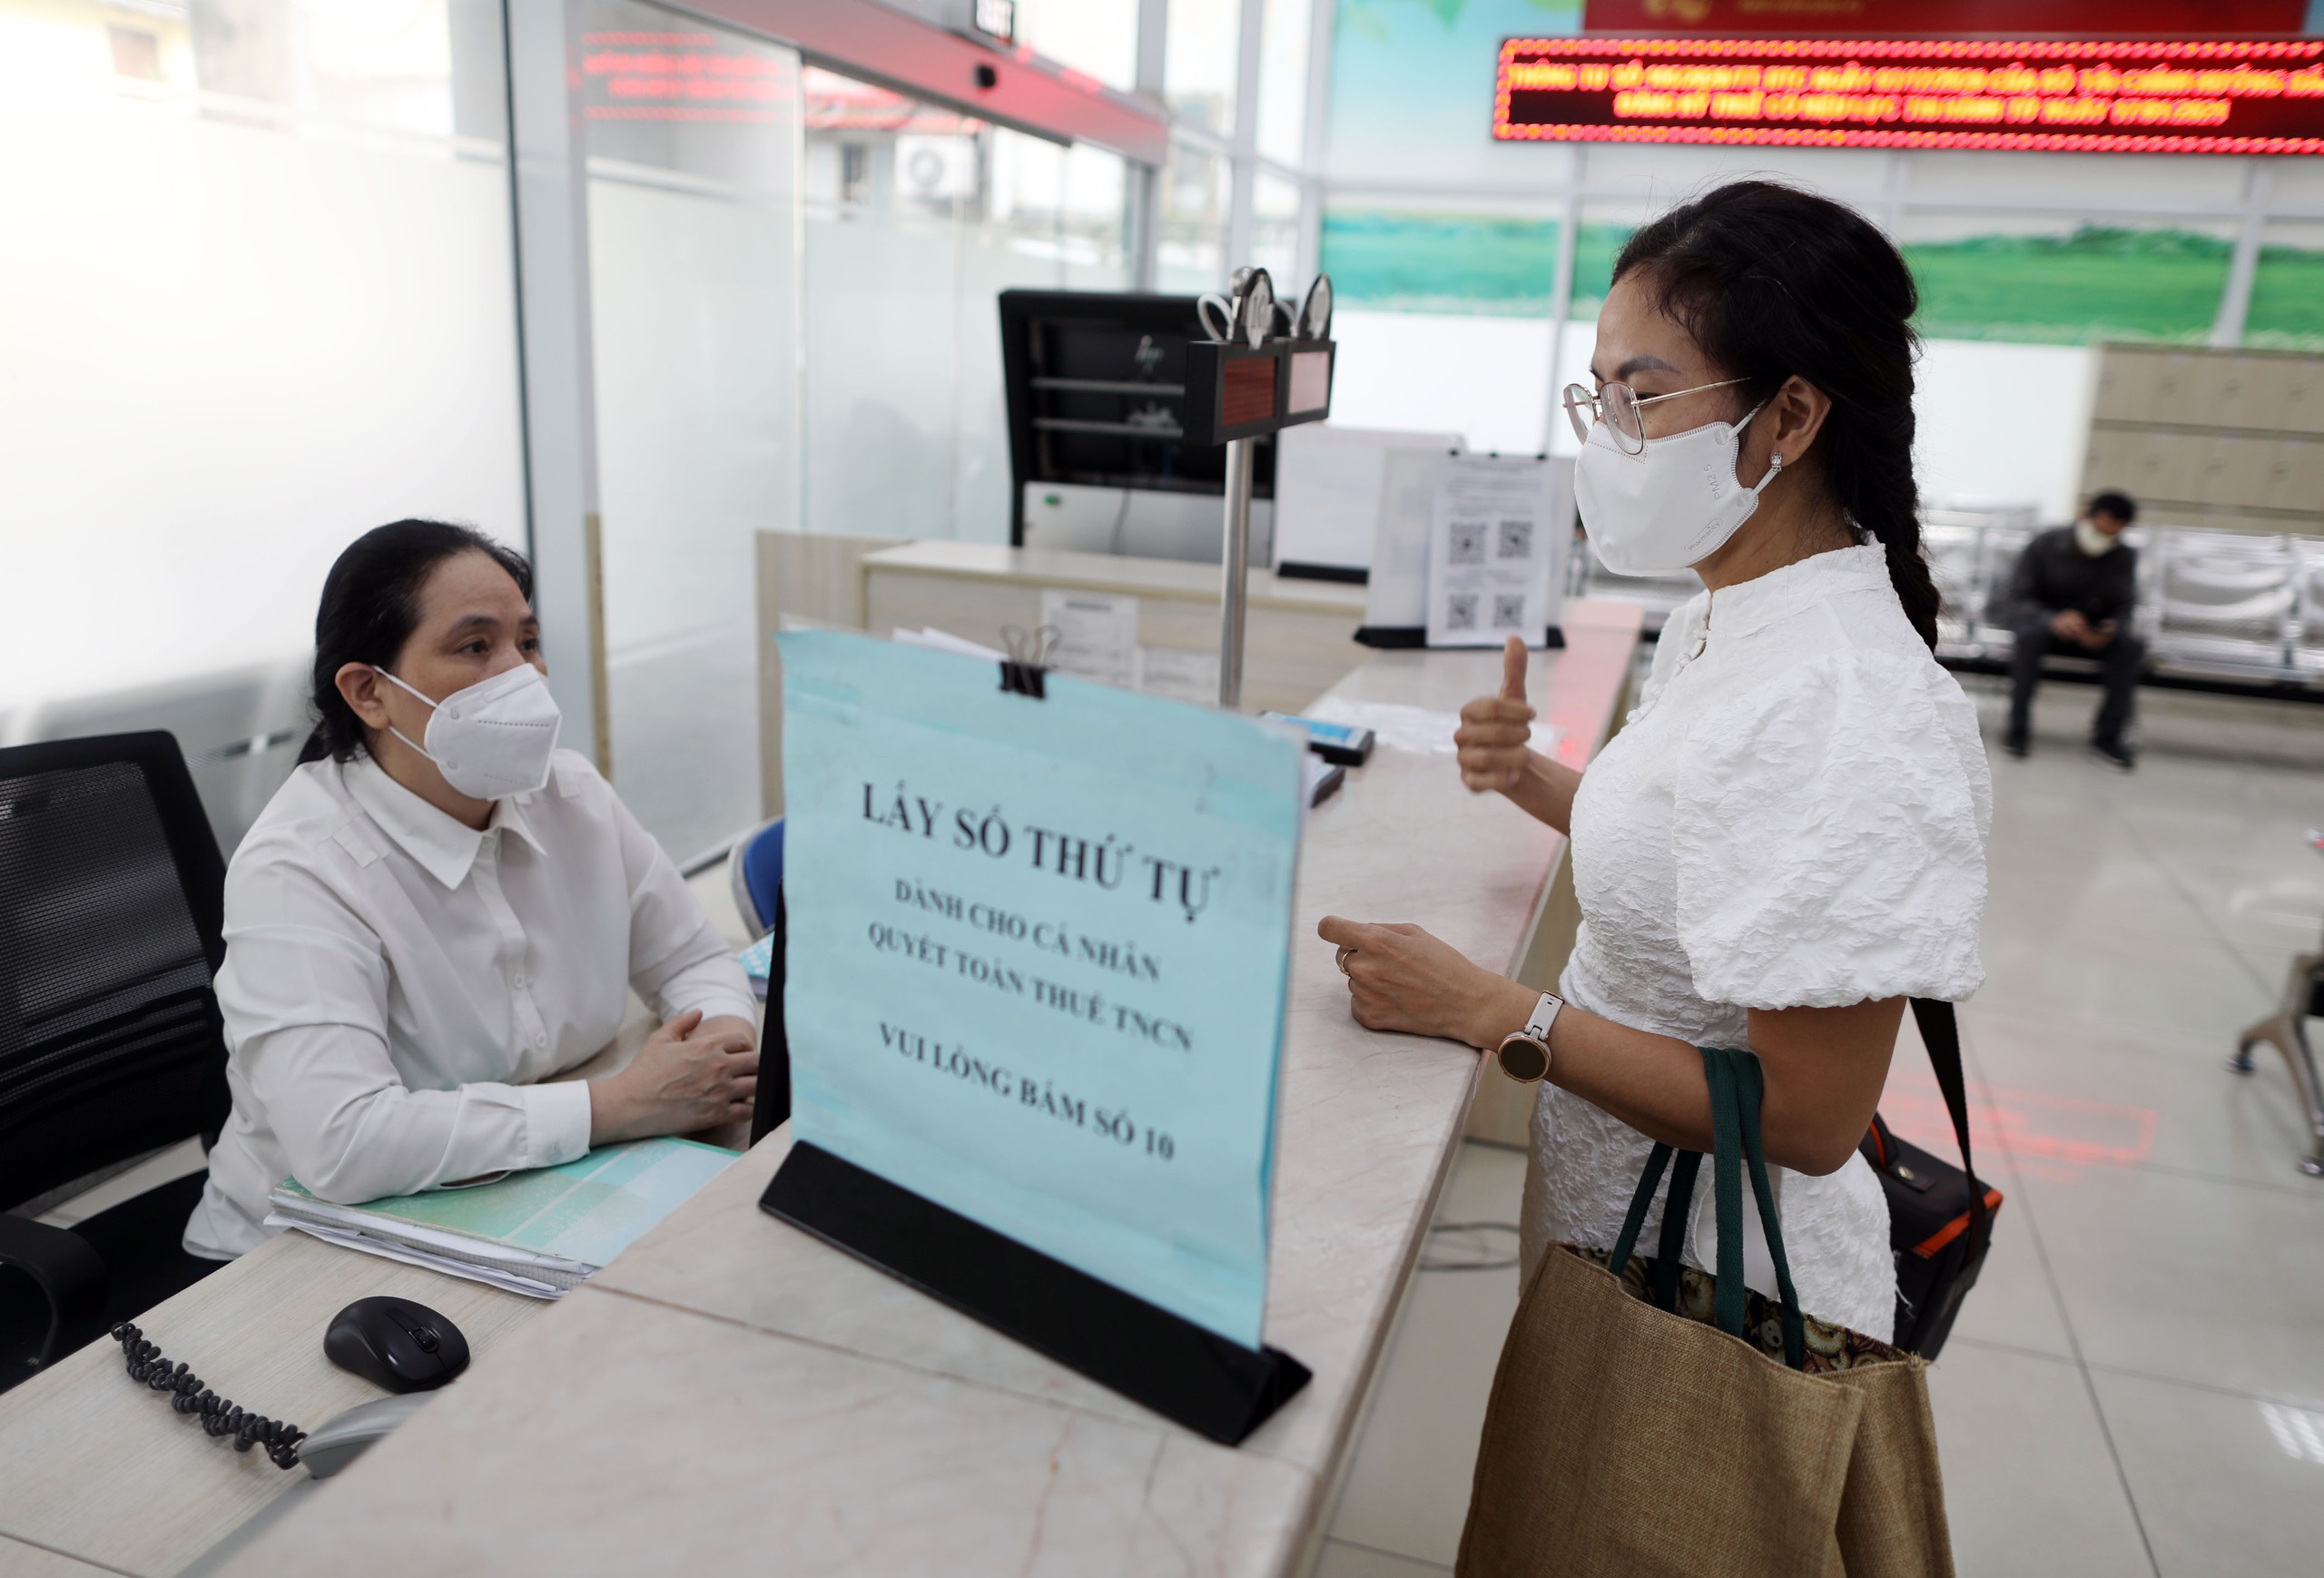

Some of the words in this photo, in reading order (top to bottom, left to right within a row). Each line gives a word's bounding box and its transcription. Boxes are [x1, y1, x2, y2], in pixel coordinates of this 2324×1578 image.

[1688, 521, 1720, 551] Pharmacity
[863, 780, 943, 841] LẤY
[954, 805, 1010, 859] SỐ
[1023, 824, 1134, 891] THỨ
[1142, 855, 1220, 923] TỰ
[868, 921, 949, 968] QUYẾT
[954, 951, 1025, 995] TOÁN
[1030, 975, 1106, 1026] THUẾ
[1111, 1002, 1194, 1052] TNCN
[895, 877, 964, 921] DÀNH
[969, 902, 1028, 942] CHO
[1078, 933, 1161, 981] NHÂN
[880, 1021, 924, 1061] VUI
[932, 1043, 1012, 1097] LÒNG
[1019, 1078, 1084, 1127] BẤM
[1093, 1106, 1135, 1146] SỐ
[1146, 1128, 1175, 1163] 10
